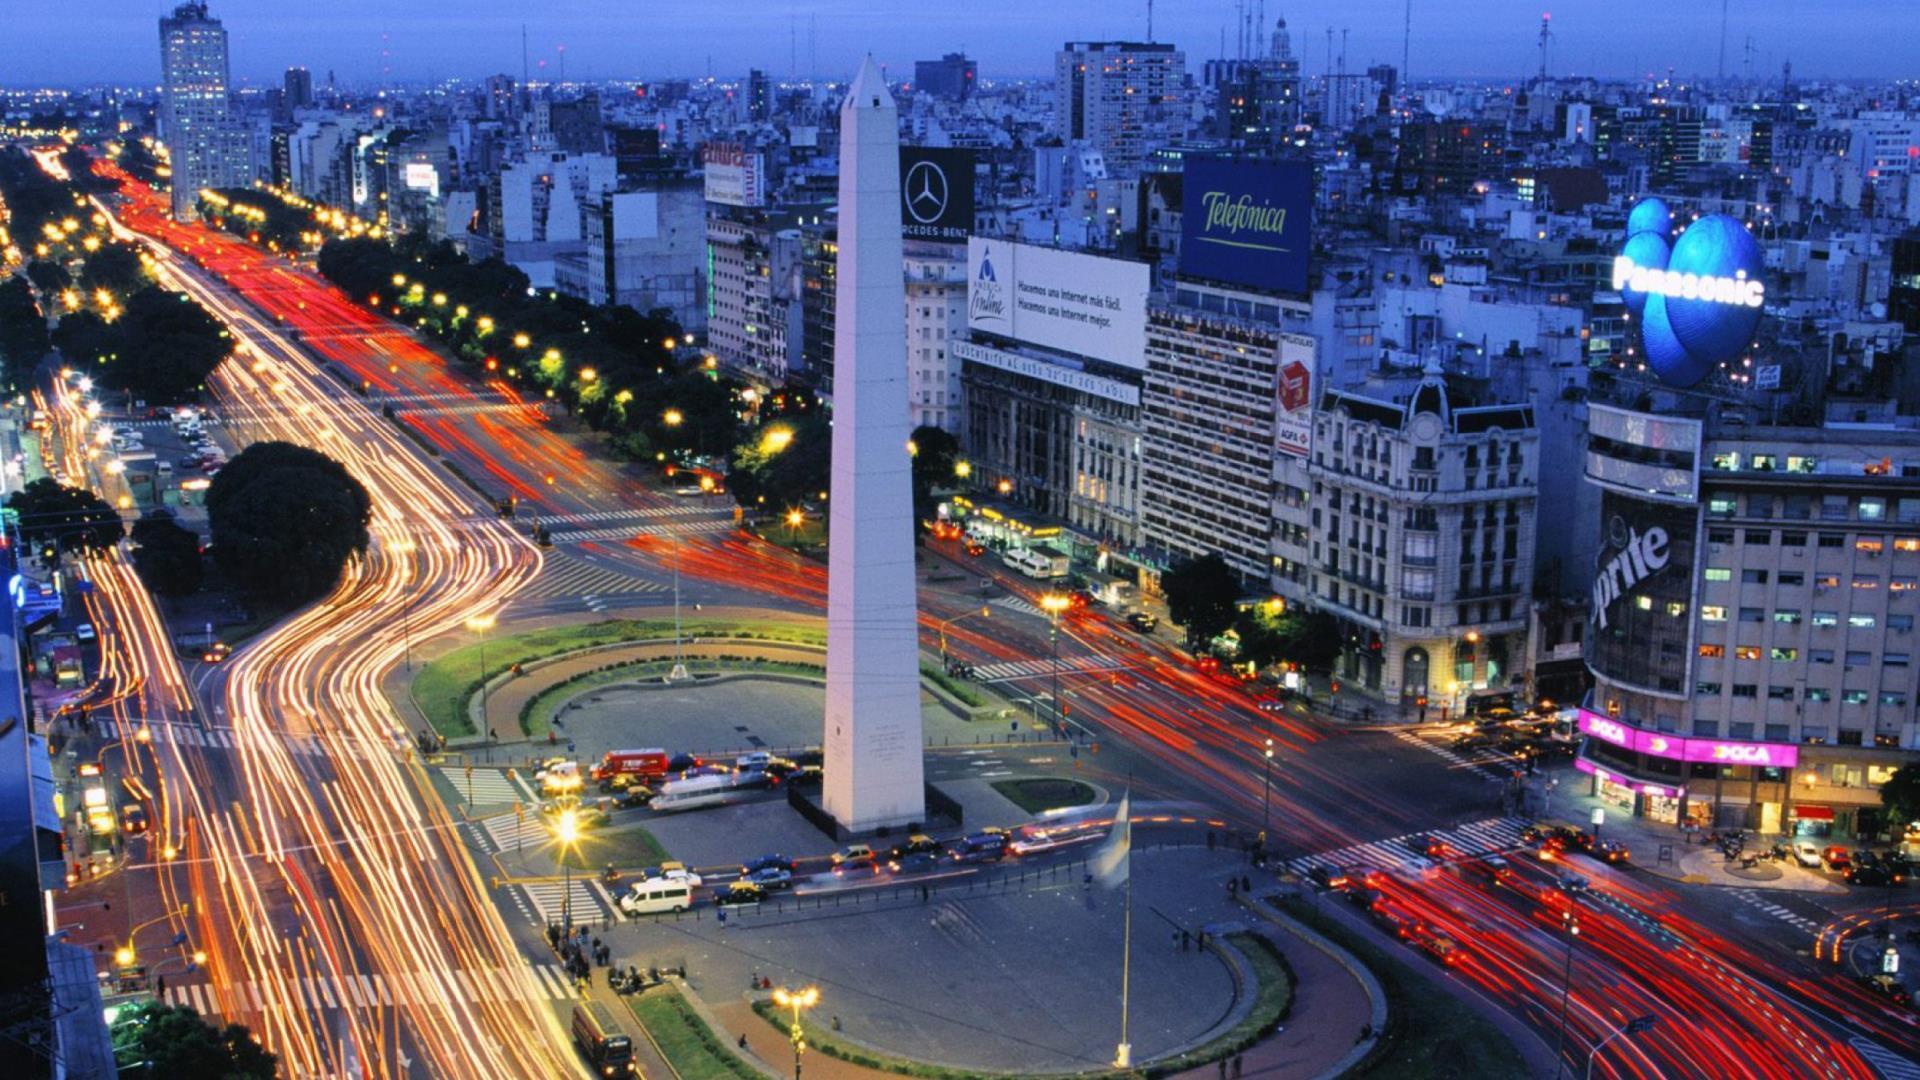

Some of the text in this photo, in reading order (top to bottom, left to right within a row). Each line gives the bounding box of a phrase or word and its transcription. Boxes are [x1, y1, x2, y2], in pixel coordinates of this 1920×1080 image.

[902, 224, 969, 238] RCEDES-BENZ
[1018, 280, 1047, 297] Hacemos
[1047, 288, 1060, 298] una
[1061, 288, 1089, 305] Internet
[1612, 256, 1765, 307] Panasonic
[1018, 297, 1047, 314] Hacemos
[1047, 306, 1060, 317] una
[1061, 306, 1088, 323] Internet
